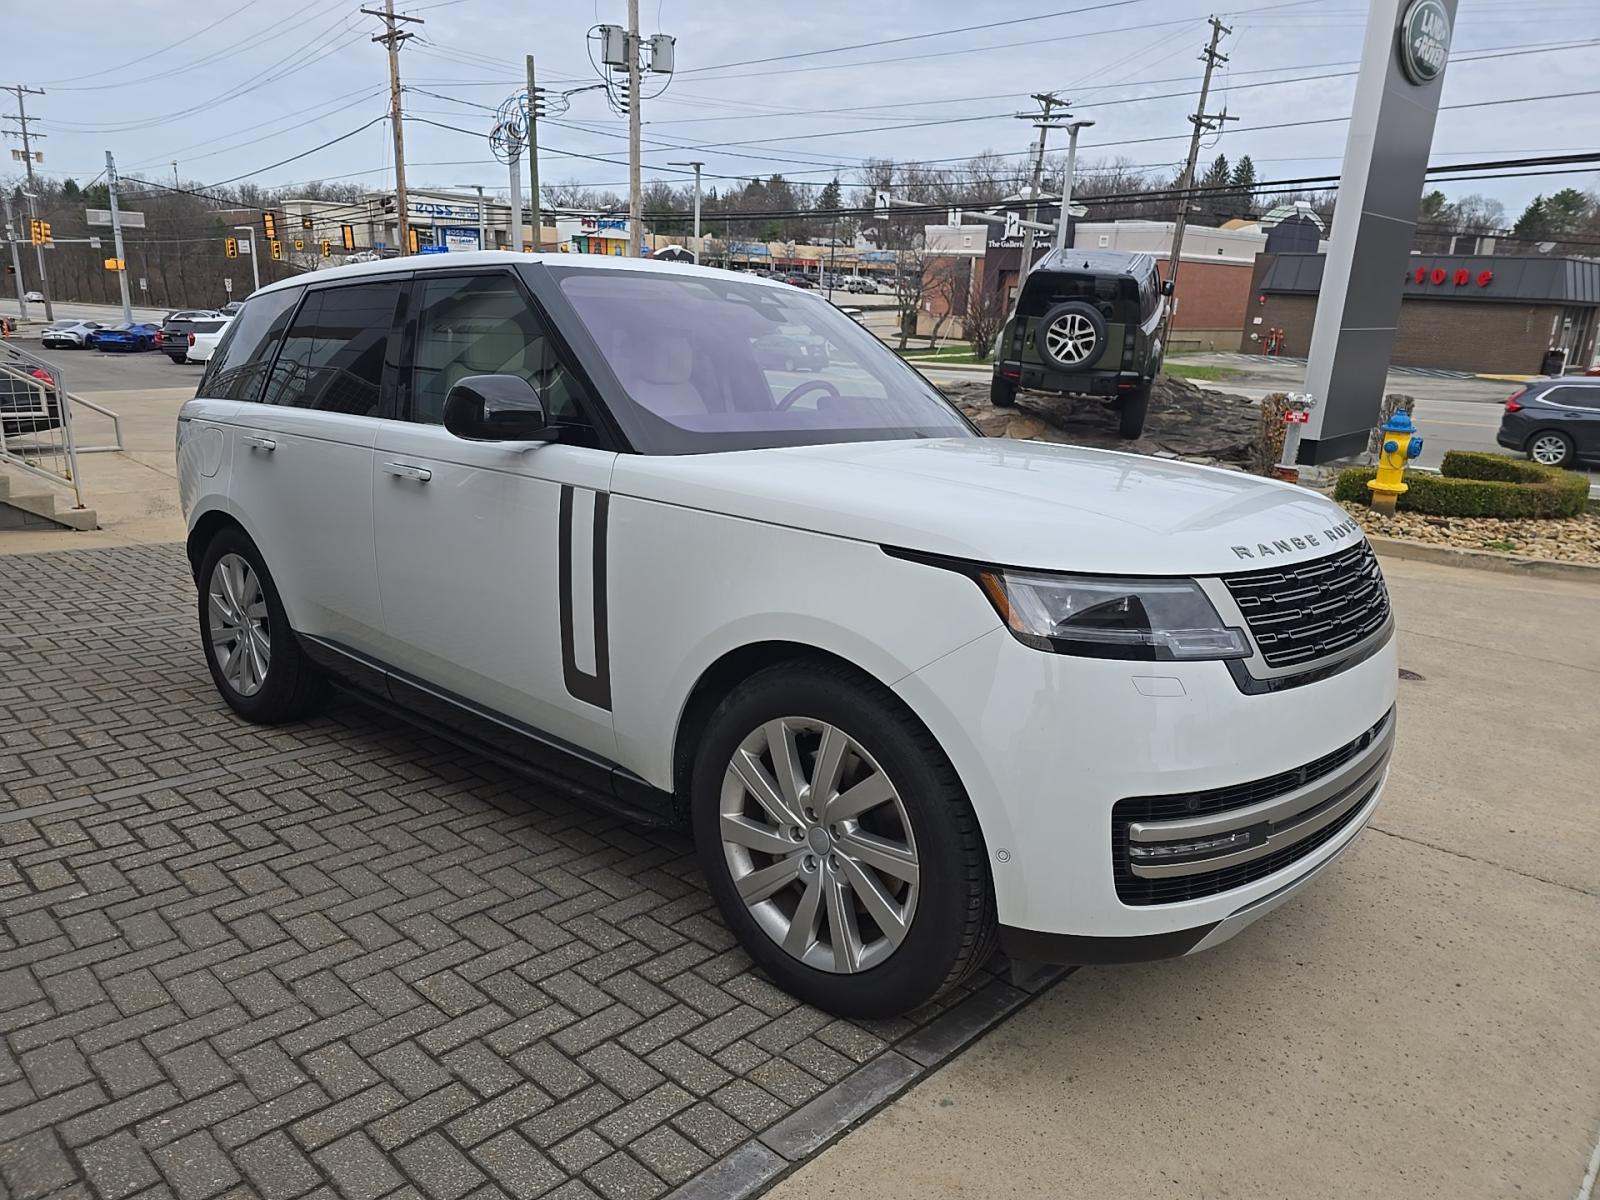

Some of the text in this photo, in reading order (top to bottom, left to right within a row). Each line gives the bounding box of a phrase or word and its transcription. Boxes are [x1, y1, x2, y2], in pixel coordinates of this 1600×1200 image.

[1420, 9, 1444, 41] LAND
[1417, 35, 1446, 69] ROVER
[988, 240, 1000, 248] The
[1404, 266, 1493, 288] tone
[1231, 518, 1358, 560] RANGE ROVE
